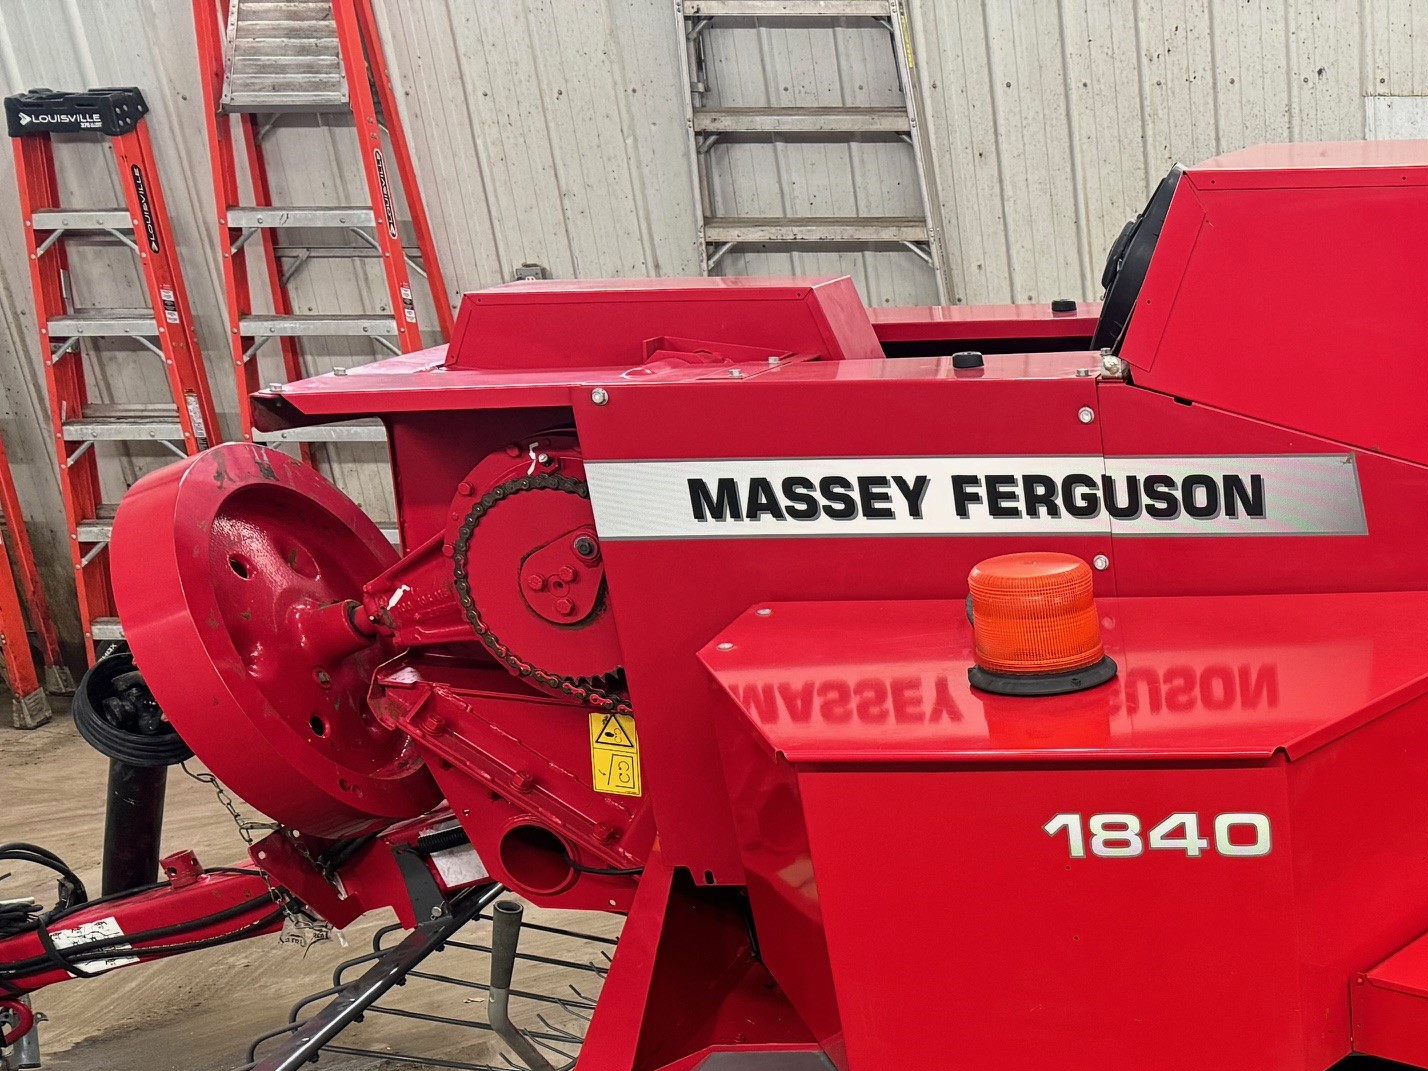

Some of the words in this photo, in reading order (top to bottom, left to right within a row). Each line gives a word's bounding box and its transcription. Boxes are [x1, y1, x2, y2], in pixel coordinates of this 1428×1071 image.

[32, 113, 102, 123] LOUISVILLE
[134, 168, 155, 240] LOUISVILLE
[376, 152, 393, 224] LOUISVILLE
[687, 475, 930, 521] MASSEY
[951, 473, 1267, 520] FERGUSON
[1042, 811, 1272, 859] 1840
